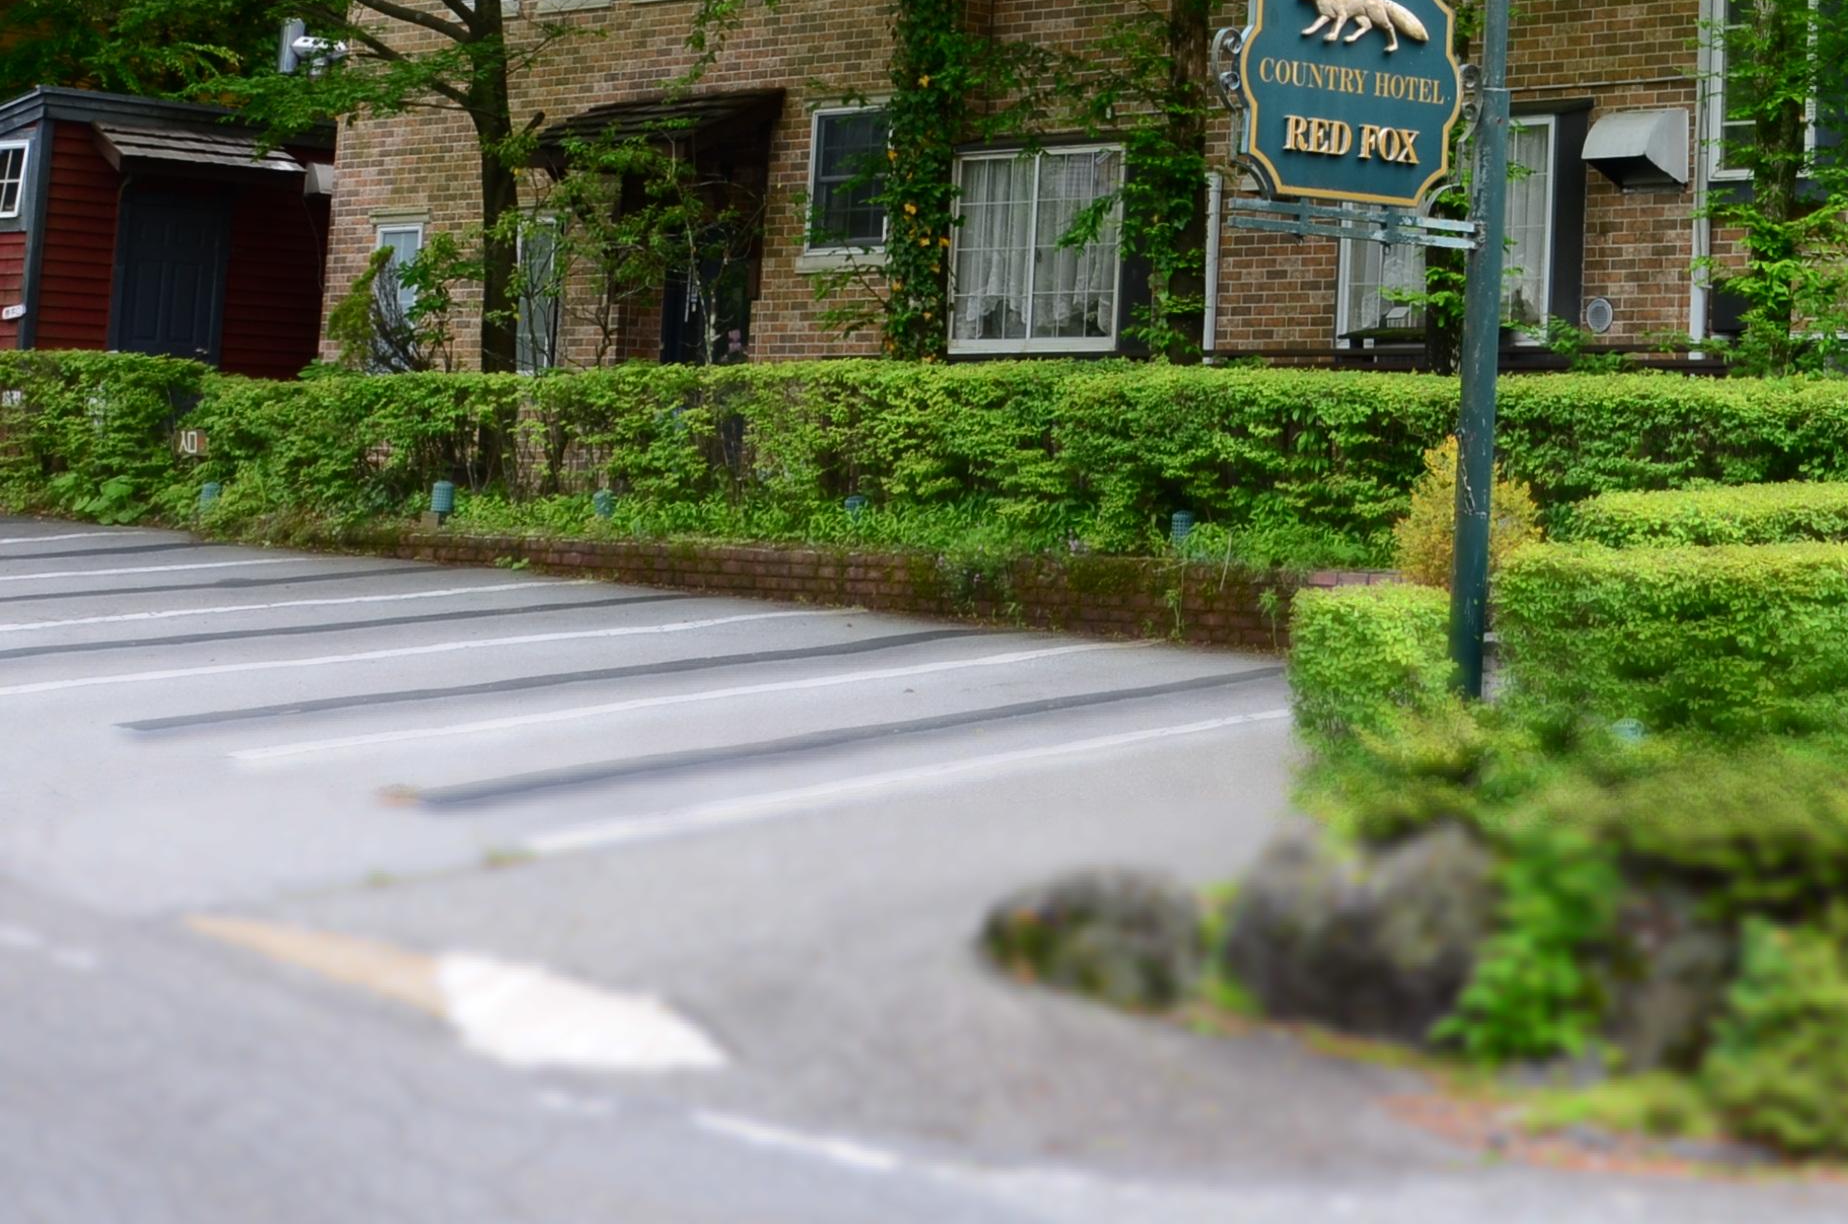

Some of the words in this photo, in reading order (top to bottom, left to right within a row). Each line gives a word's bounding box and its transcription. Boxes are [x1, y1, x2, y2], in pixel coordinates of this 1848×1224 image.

[1260, 58, 1367, 94] COUNTRY
[1374, 72, 1444, 105] HOTEL
[1283, 115, 1352, 156] RED
[1358, 124, 1420, 165] FOX
